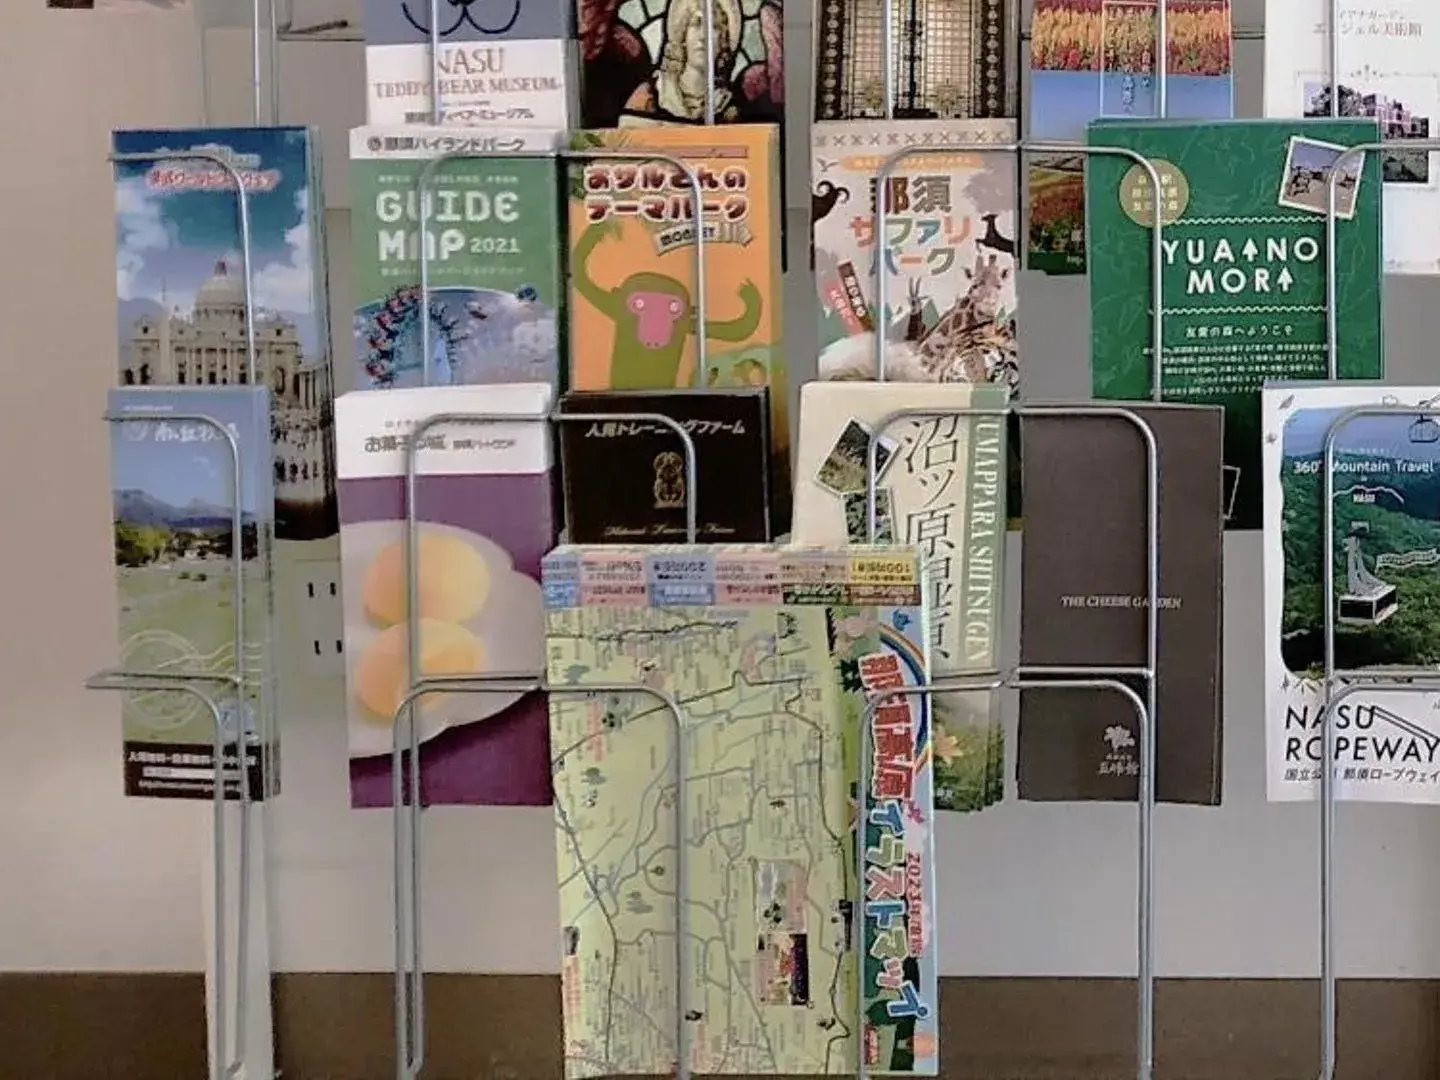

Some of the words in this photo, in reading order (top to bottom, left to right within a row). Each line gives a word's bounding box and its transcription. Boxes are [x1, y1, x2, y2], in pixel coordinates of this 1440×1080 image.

[376, 190, 520, 222] GUIDE
[848, 216, 973, 248] サファリ
[470, 237, 522, 254] 2021
[972, 415, 1001, 535] UMAPPARA
[1395, 458, 1435, 473] Travel
[1061, 595, 1086, 608] THE
